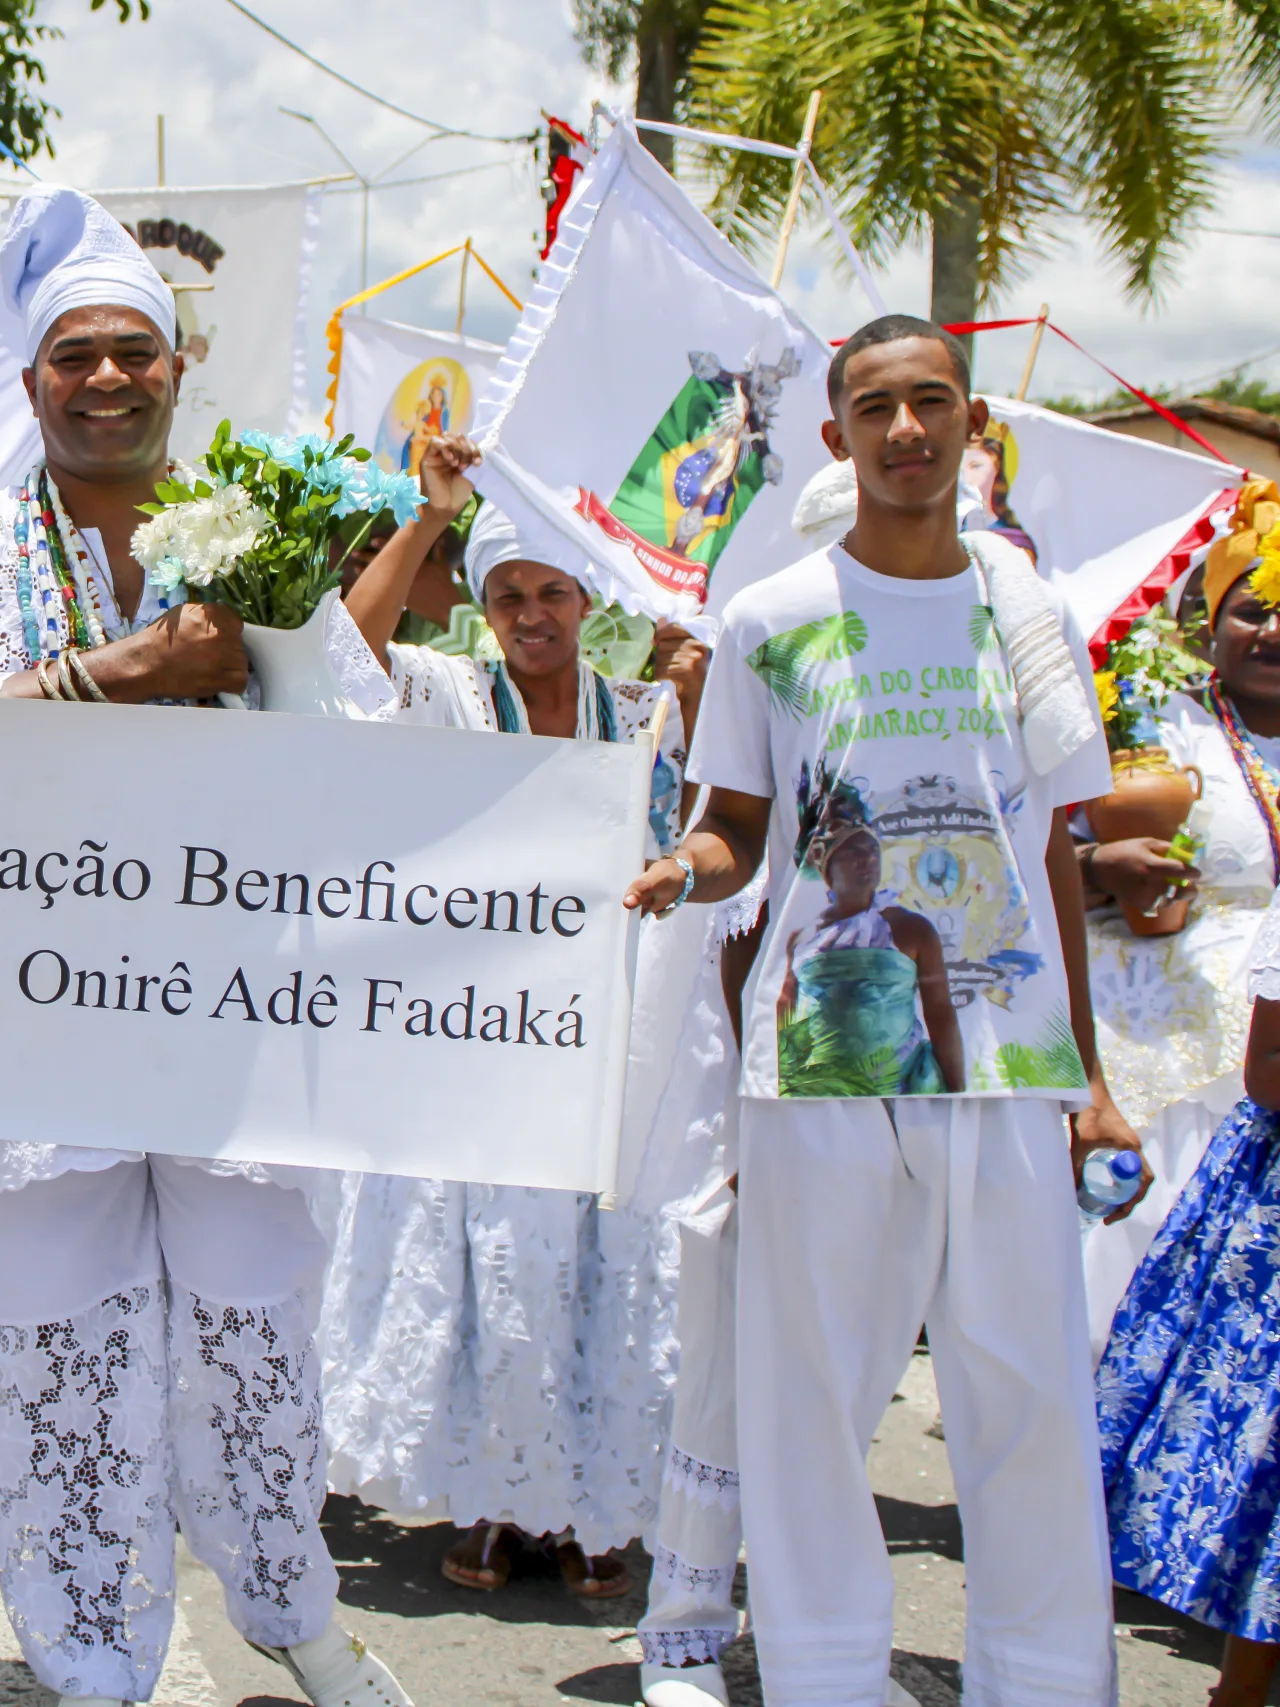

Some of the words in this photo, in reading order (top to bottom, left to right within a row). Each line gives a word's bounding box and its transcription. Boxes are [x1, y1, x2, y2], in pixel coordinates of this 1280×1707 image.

[879, 668, 911, 695] DO
[174, 845, 586, 938] Beneficente
[18, 949, 193, 1016] Onirê
[207, 966, 338, 1029] Adê
[359, 978, 586, 1048] Fadaká
